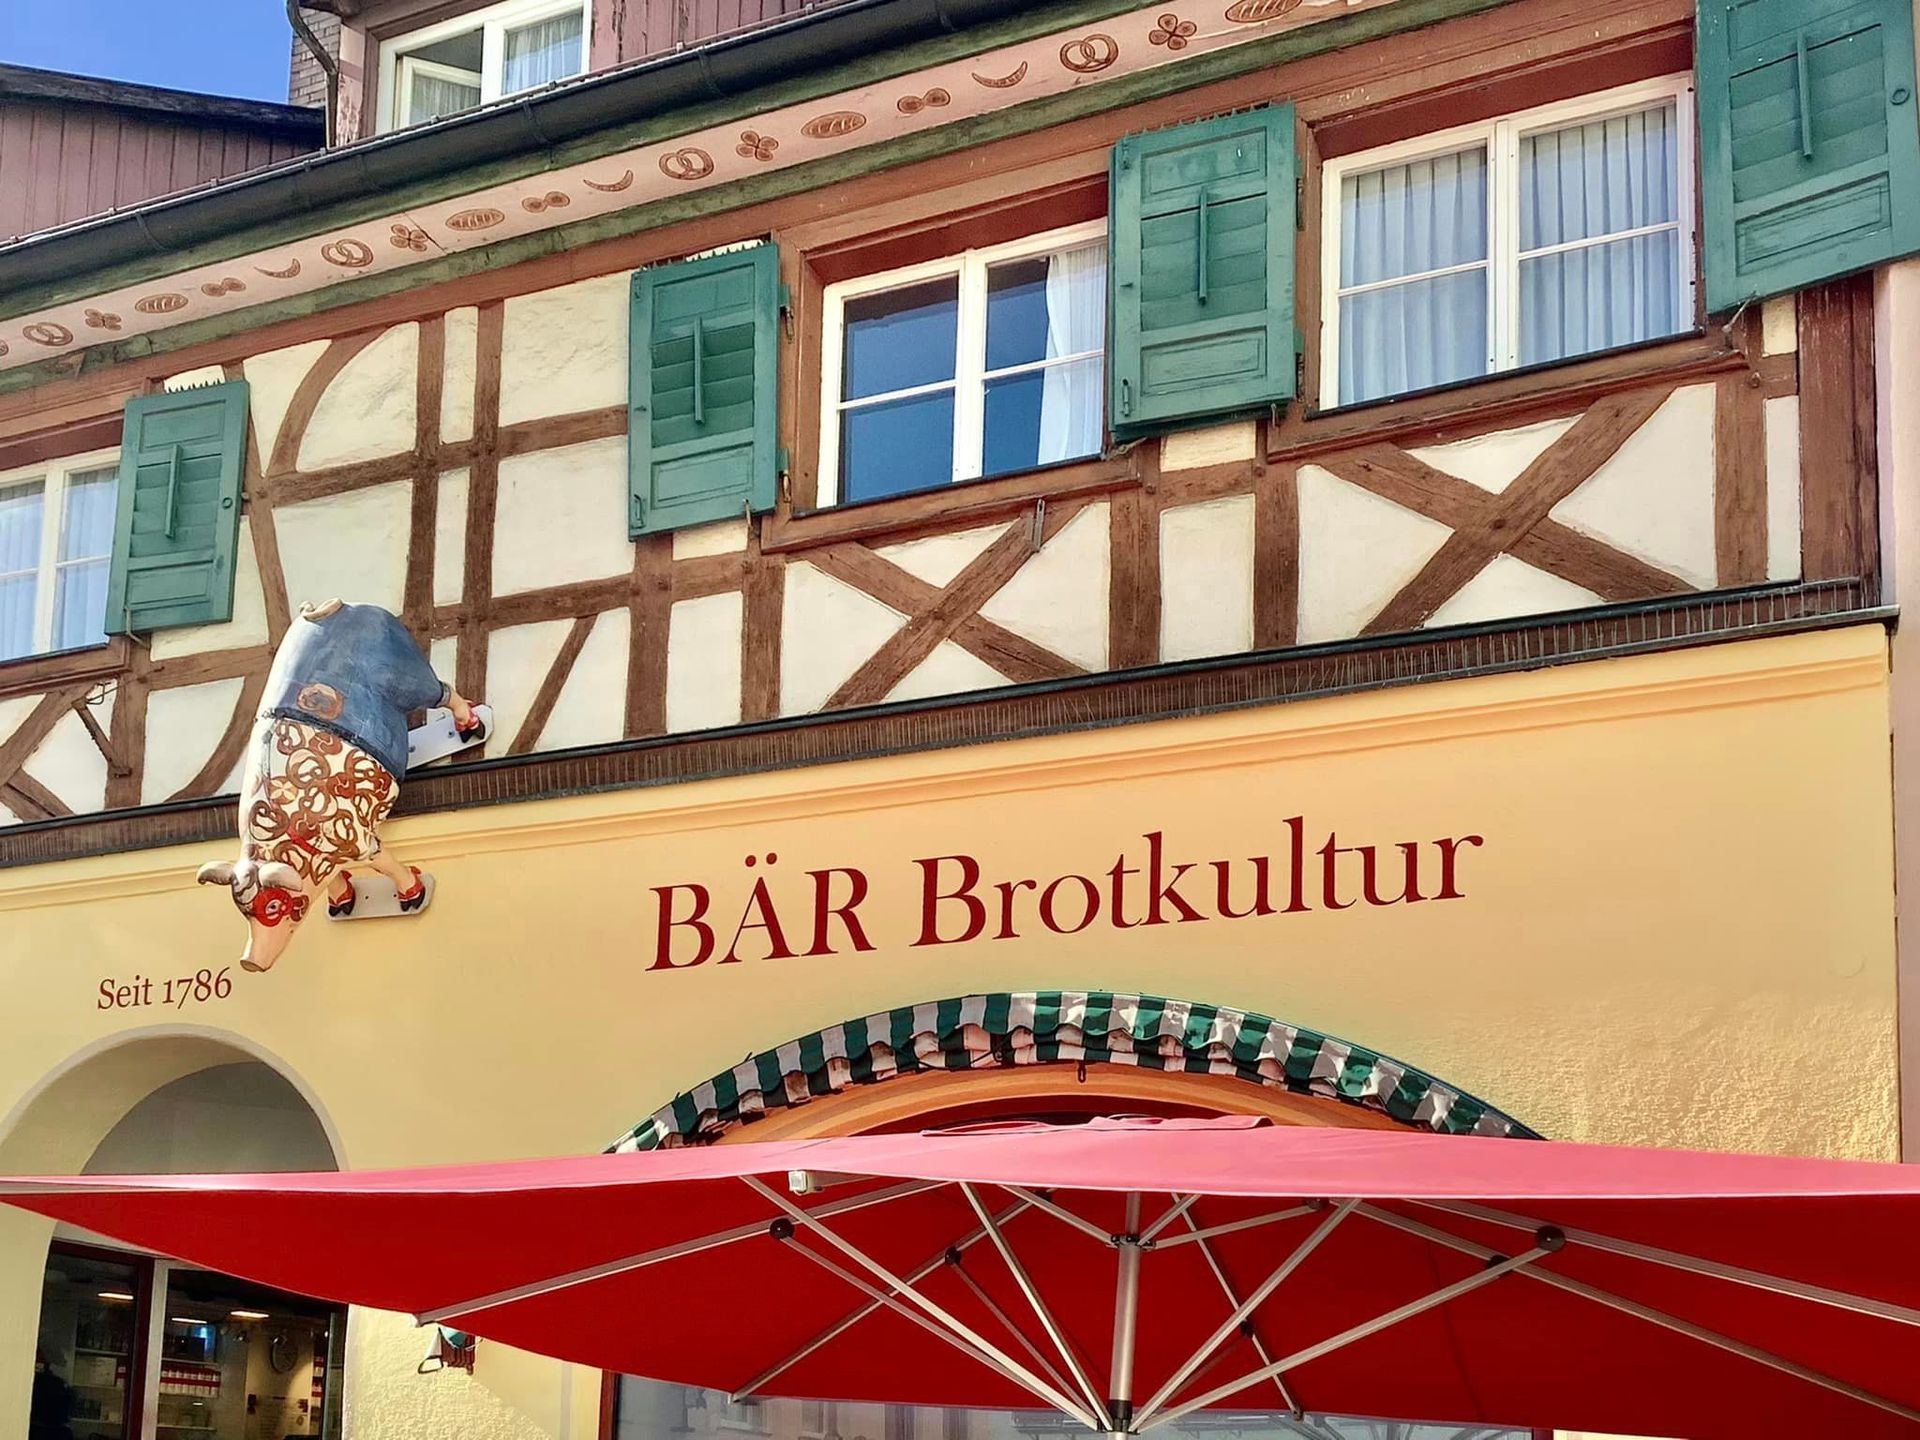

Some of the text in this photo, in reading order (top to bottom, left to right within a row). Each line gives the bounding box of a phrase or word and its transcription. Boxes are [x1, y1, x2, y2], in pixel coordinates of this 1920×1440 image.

[644, 815, 1484, 972] BÄR Brotkultur
[97, 966, 232, 1010] Seit 1786
